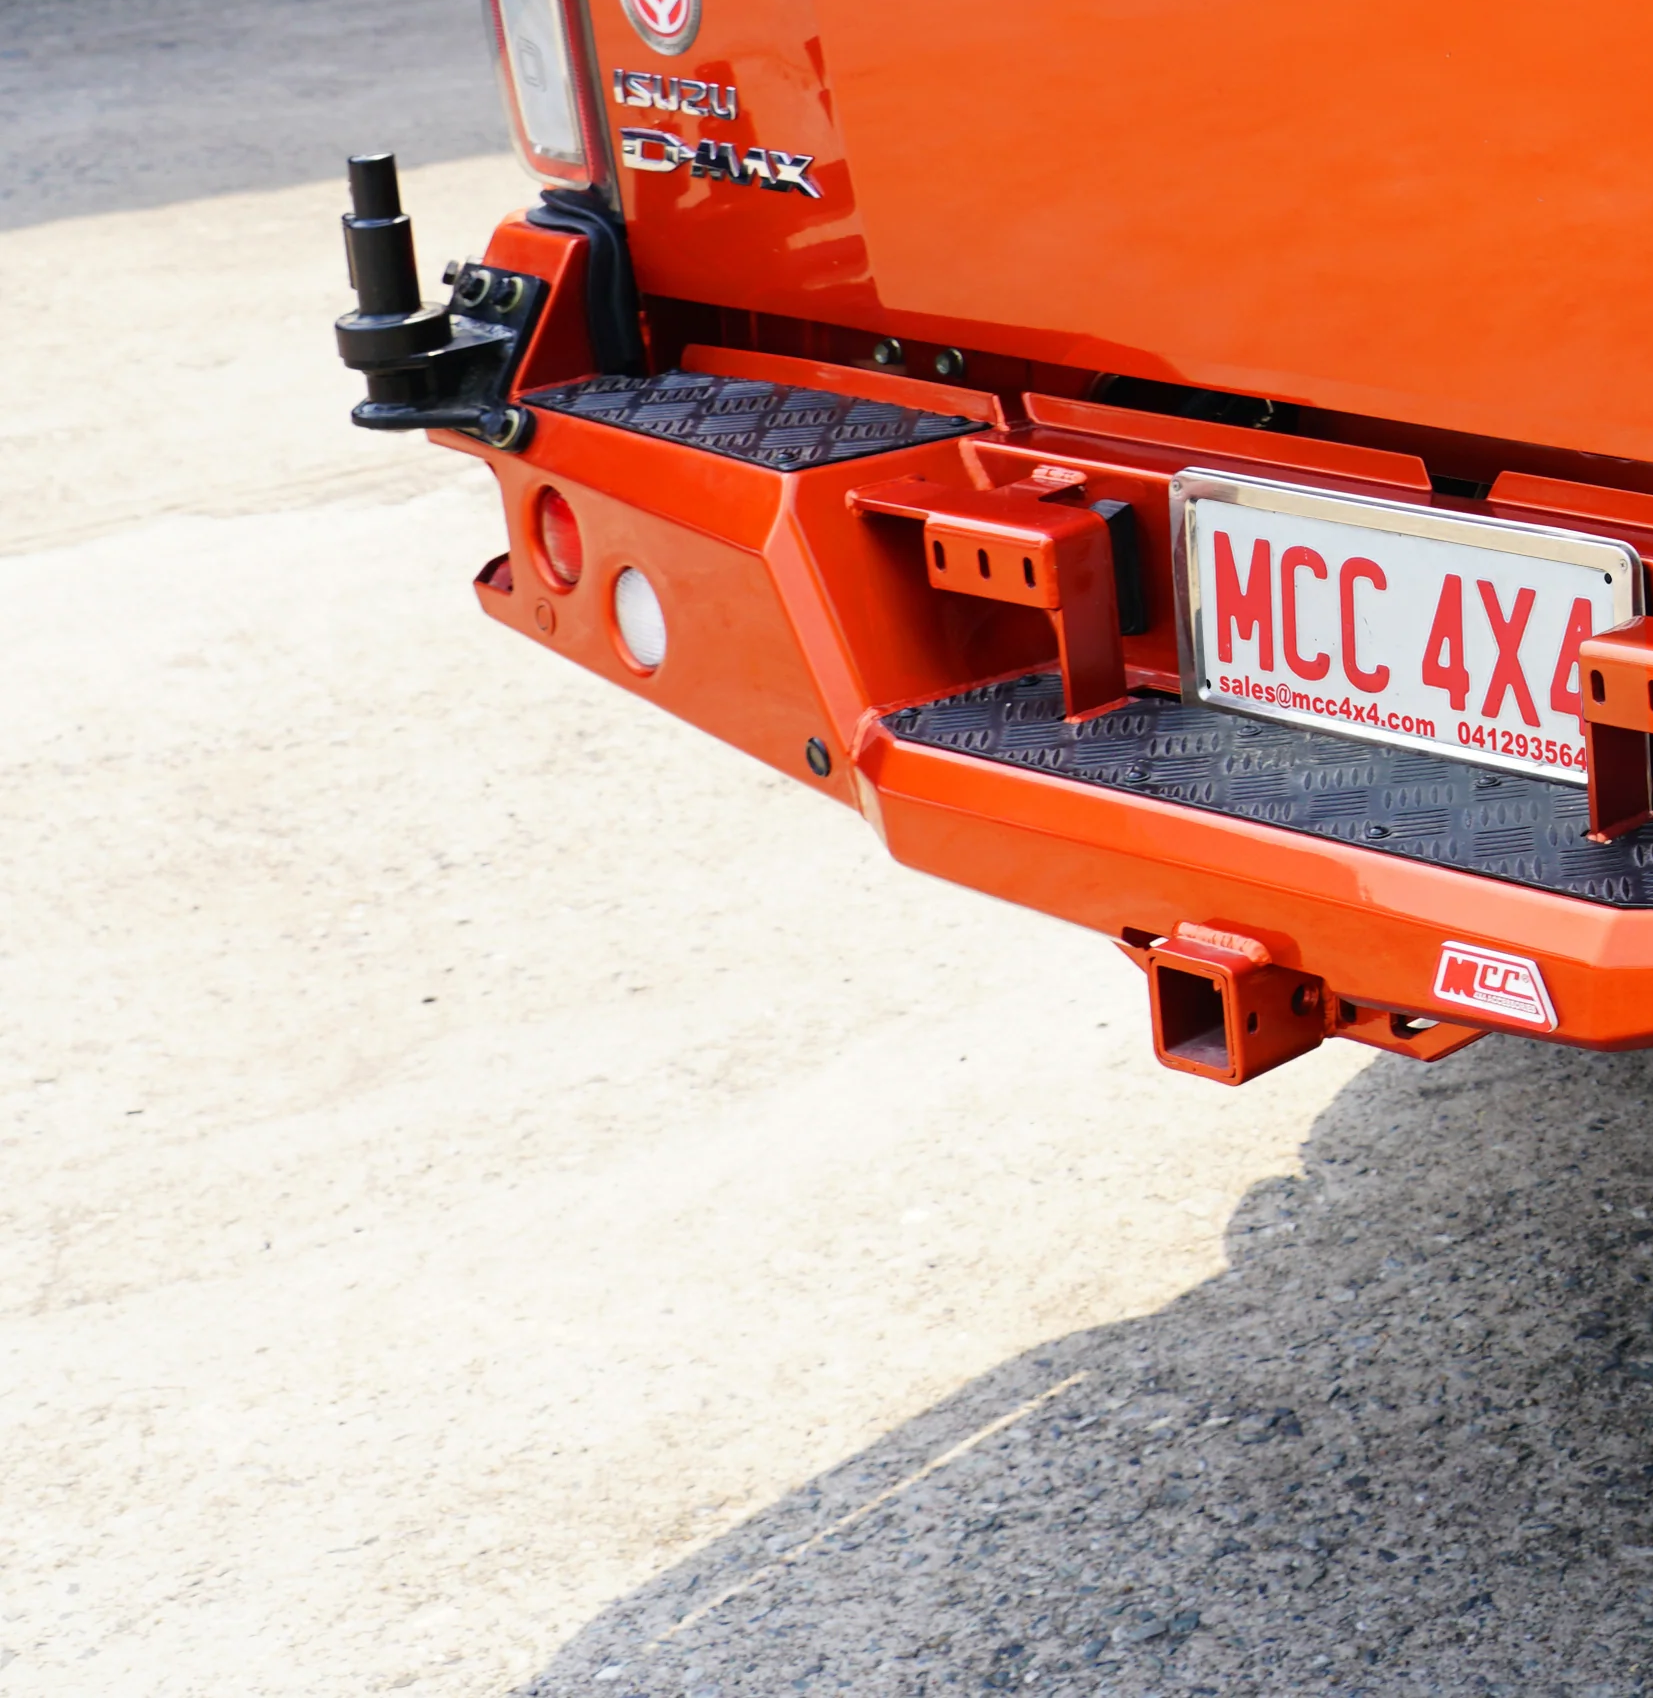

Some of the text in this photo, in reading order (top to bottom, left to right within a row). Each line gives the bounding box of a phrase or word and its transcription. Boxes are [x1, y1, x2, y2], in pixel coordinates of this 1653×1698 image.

[612, 68, 738, 121] ISUZU
[1213, 530, 1593, 737] MCC 4X4
[1218, 673, 1437, 739] sales@mcc4x4.com
[1440, 955, 1536, 1001] MCC
